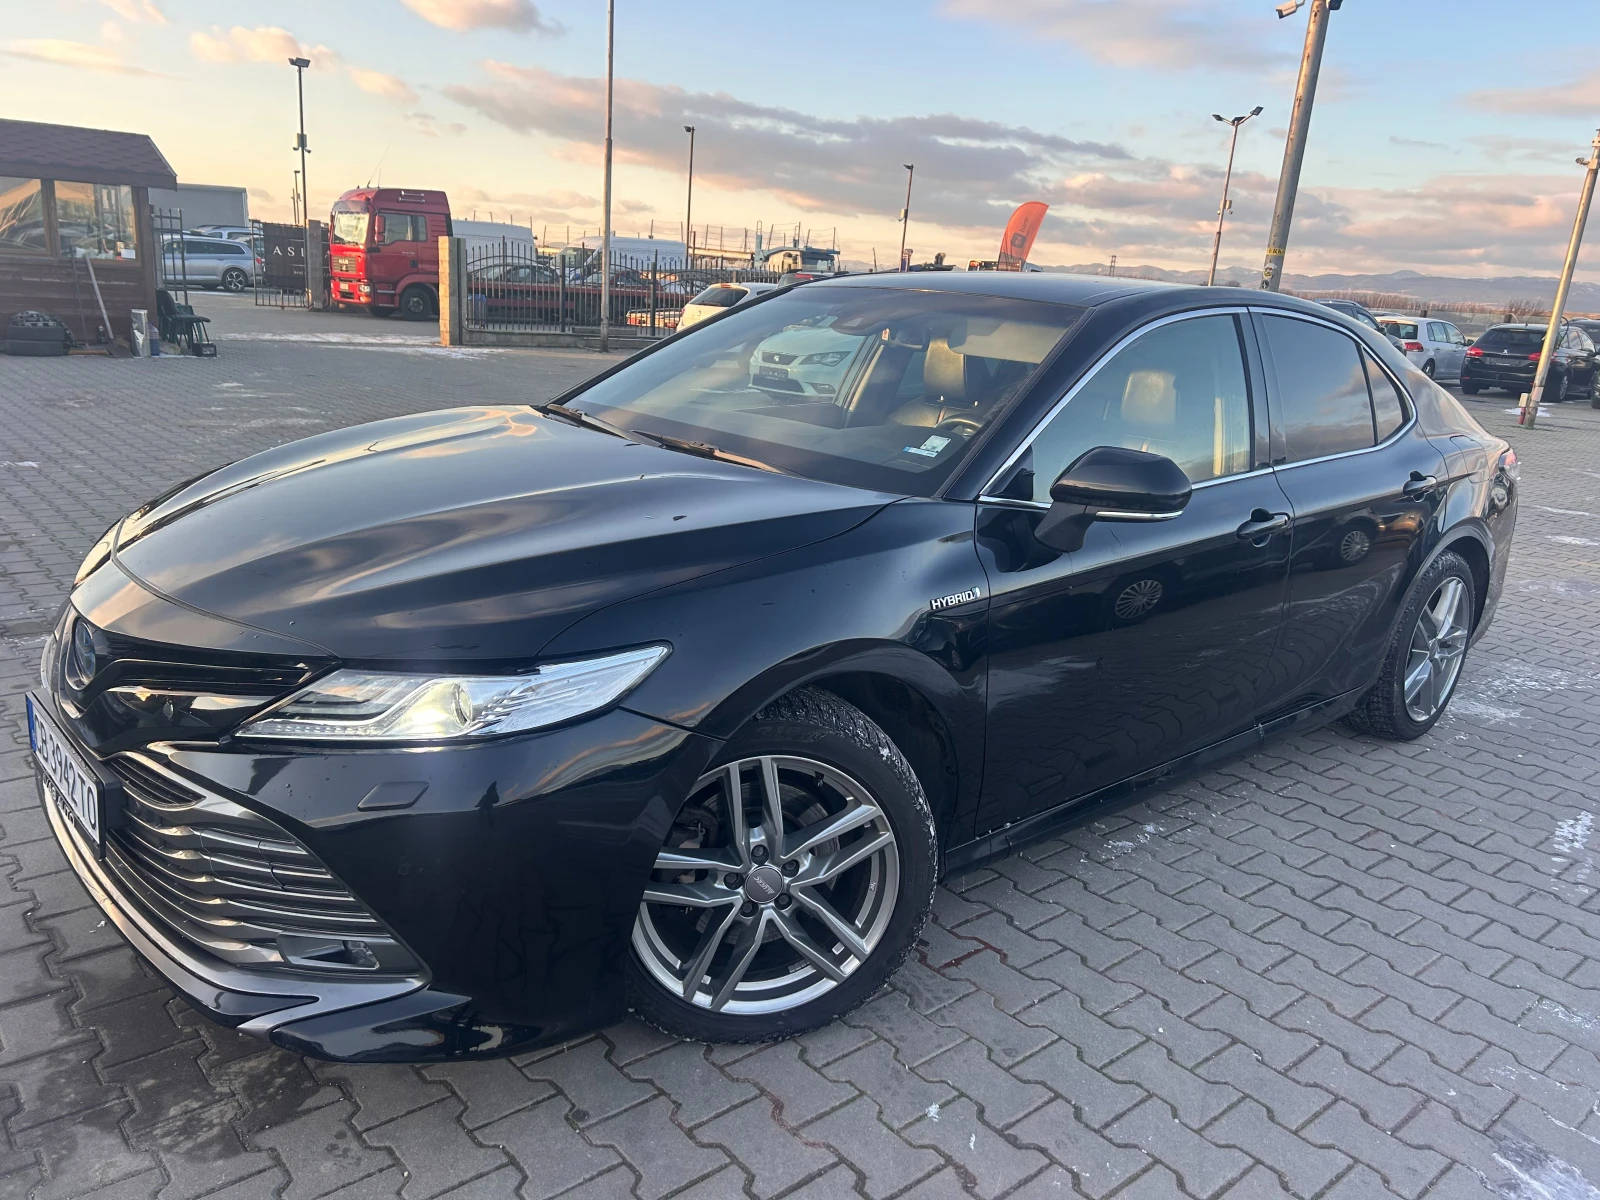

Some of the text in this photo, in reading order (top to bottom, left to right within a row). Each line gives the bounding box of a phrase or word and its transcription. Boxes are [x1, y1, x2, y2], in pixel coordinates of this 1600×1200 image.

[1020, 217, 1029, 232] bank
[931, 590, 974, 610] HYBRID
[49, 733, 78, 807] 3942
